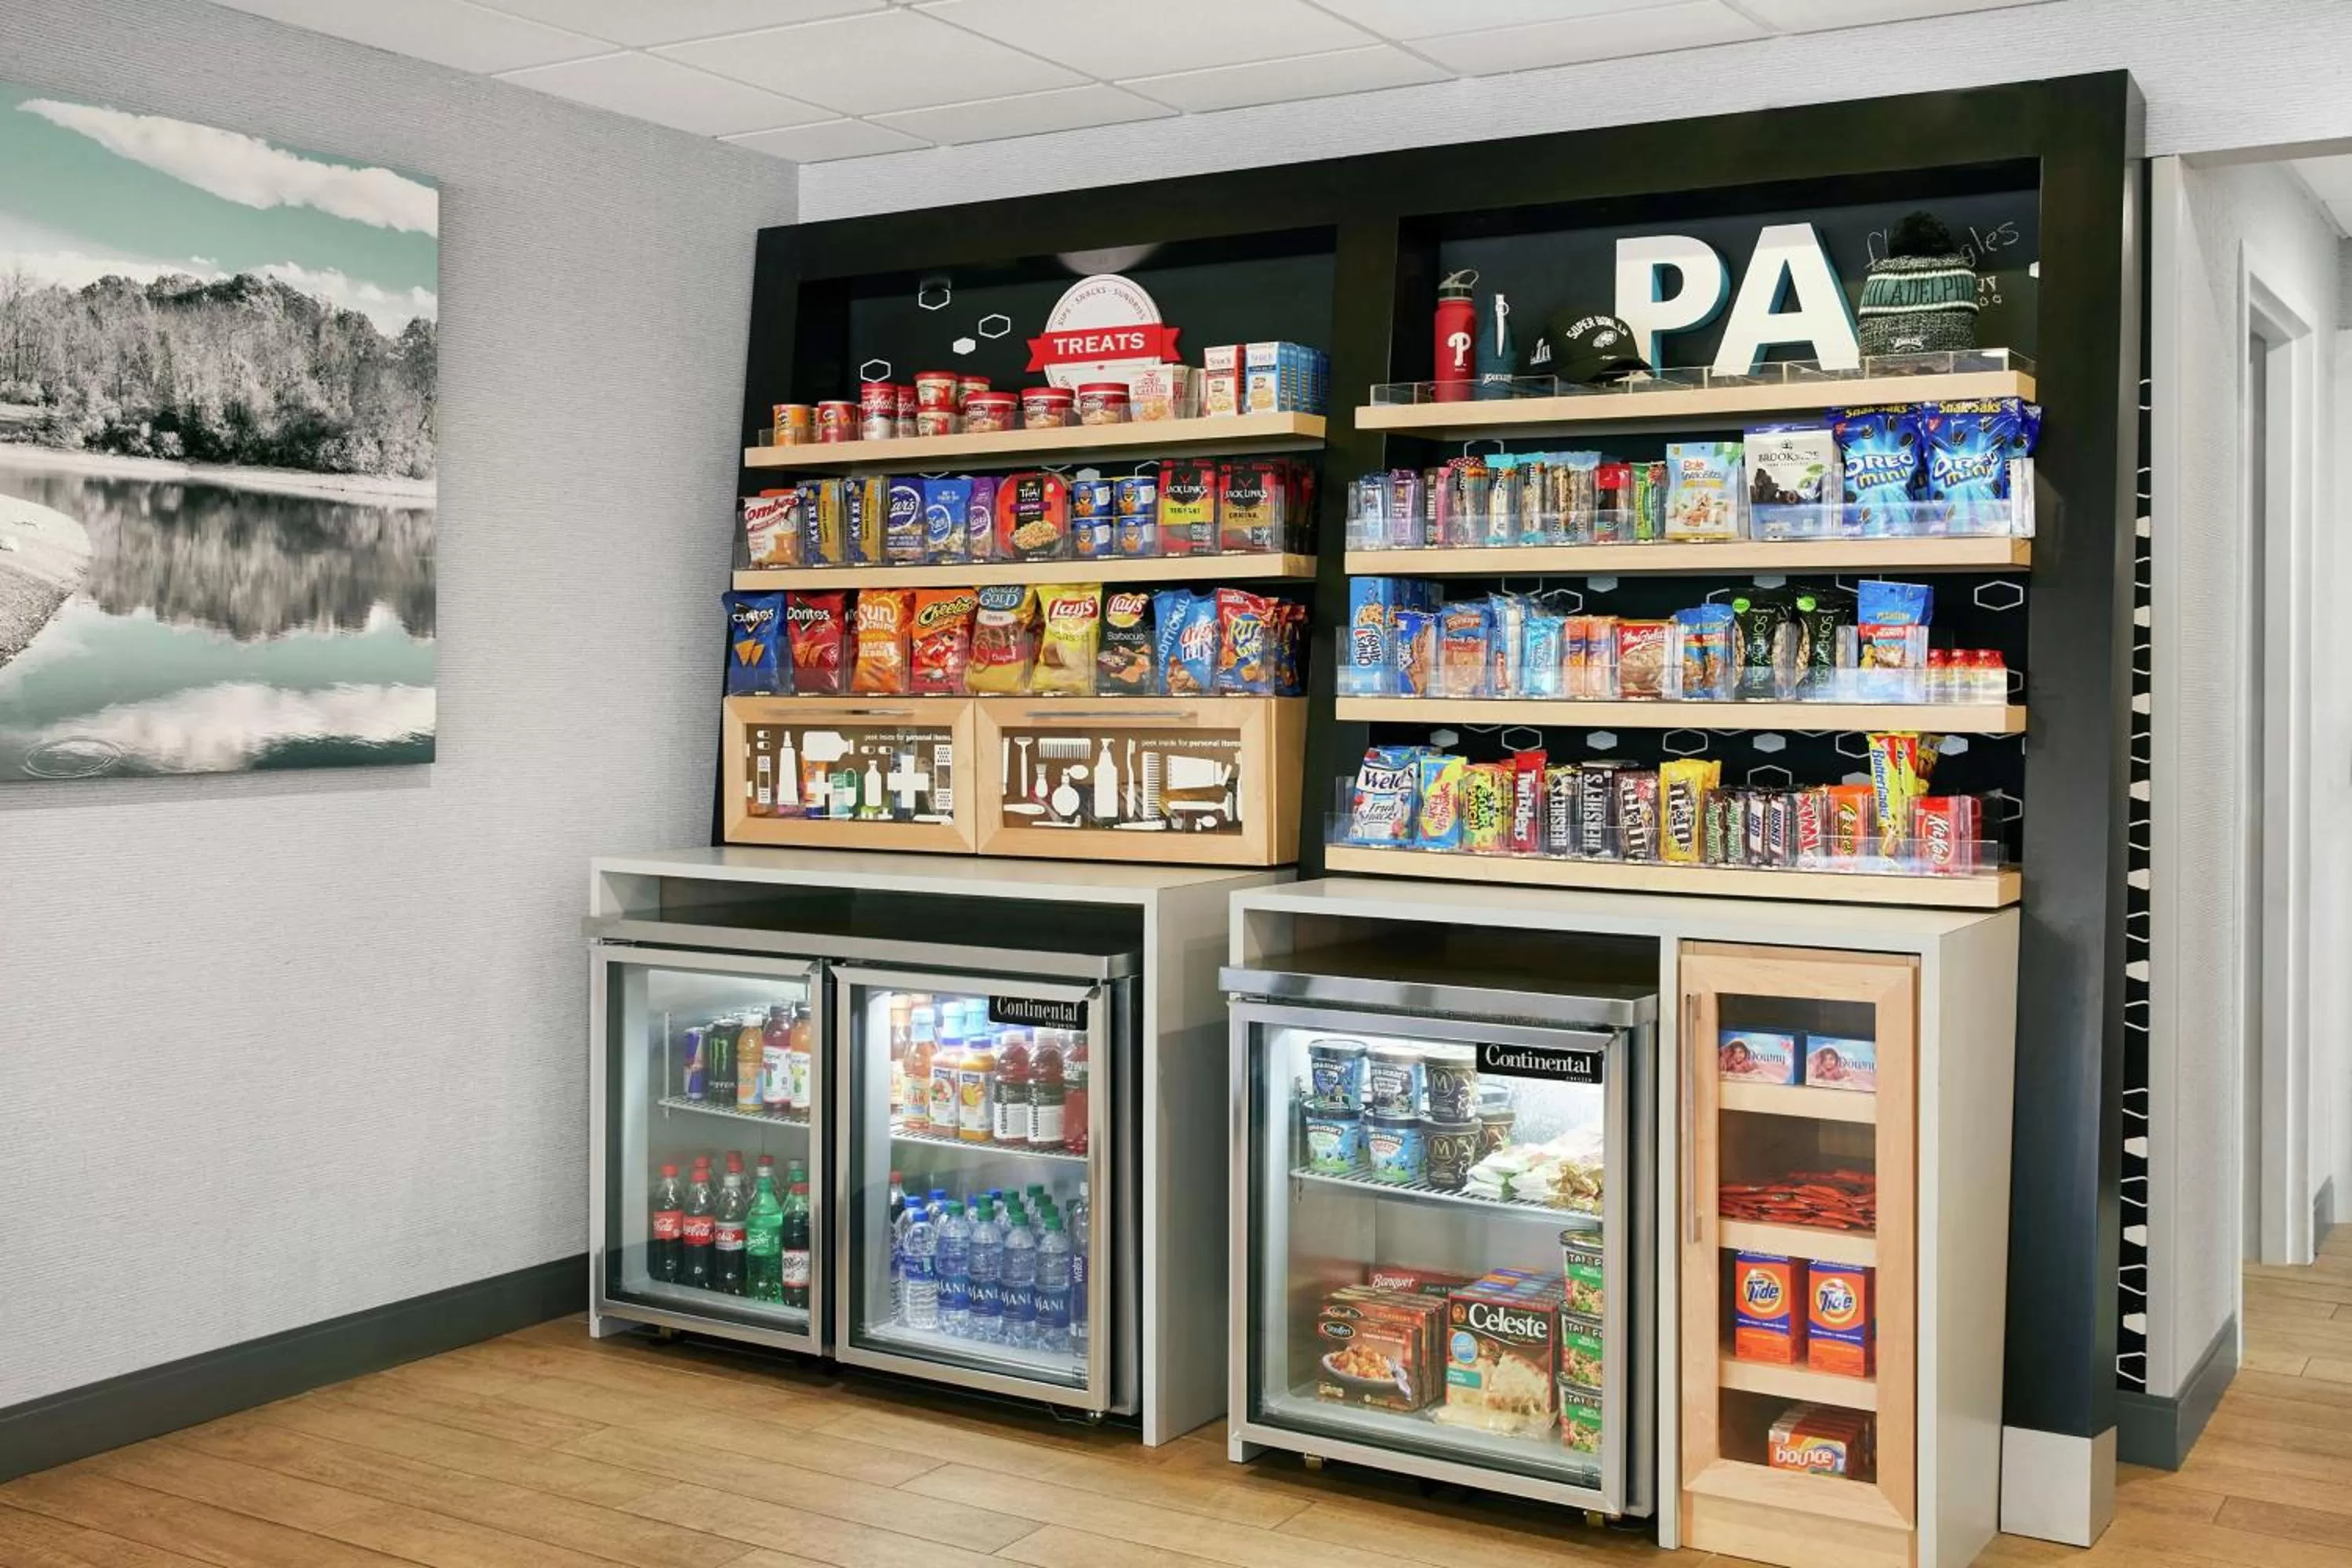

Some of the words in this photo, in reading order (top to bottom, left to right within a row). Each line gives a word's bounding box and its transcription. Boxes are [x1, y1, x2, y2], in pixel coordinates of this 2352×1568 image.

[1614, 222, 1860, 377] PA
[1566, 317, 1595, 339] SUPER
[1594, 315, 1618, 329] BOWL
[1053, 332, 1145, 355] TREATS
[1845, 451, 1915, 477] OREO
[1166, 485, 1182, 495] JACK
[1183, 485, 1208, 495] LINK'S
[1857, 467, 1907, 490] mini
[1225, 488, 1243, 499] JACK
[979, 592, 1018, 606] GOLD
[1051, 599, 1095, 619] Lay's
[1109, 593, 1145, 614] Lay's
[786, 607, 831, 621] Doritos
[858, 602, 898, 631] Sun
[919, 597, 975, 626] Cheetos
[1106, 631, 1145, 641] Barbecue
[1229, 619, 1265, 643] RITZ
[1355, 636, 1372, 667] Chips
[1752, 615, 1768, 689] PISTACHIOS
[1178, 738, 1188, 747] for
[1871, 748, 1891, 822] Butterfinger
[1466, 786, 1479, 830] PATCH
[1477, 786, 1490, 828] SOUR
[1582, 774, 1605, 850] HERSHEY'S
[996, 996, 1077, 1022] Continental
[1485, 1044, 1592, 1074] Continental
[1748, 1279, 1779, 1302] Tide
[1820, 1290, 1853, 1312] Tide
[1468, 1302, 1548, 1339] Celeste
[1775, 1444, 1833, 1465] bounce
